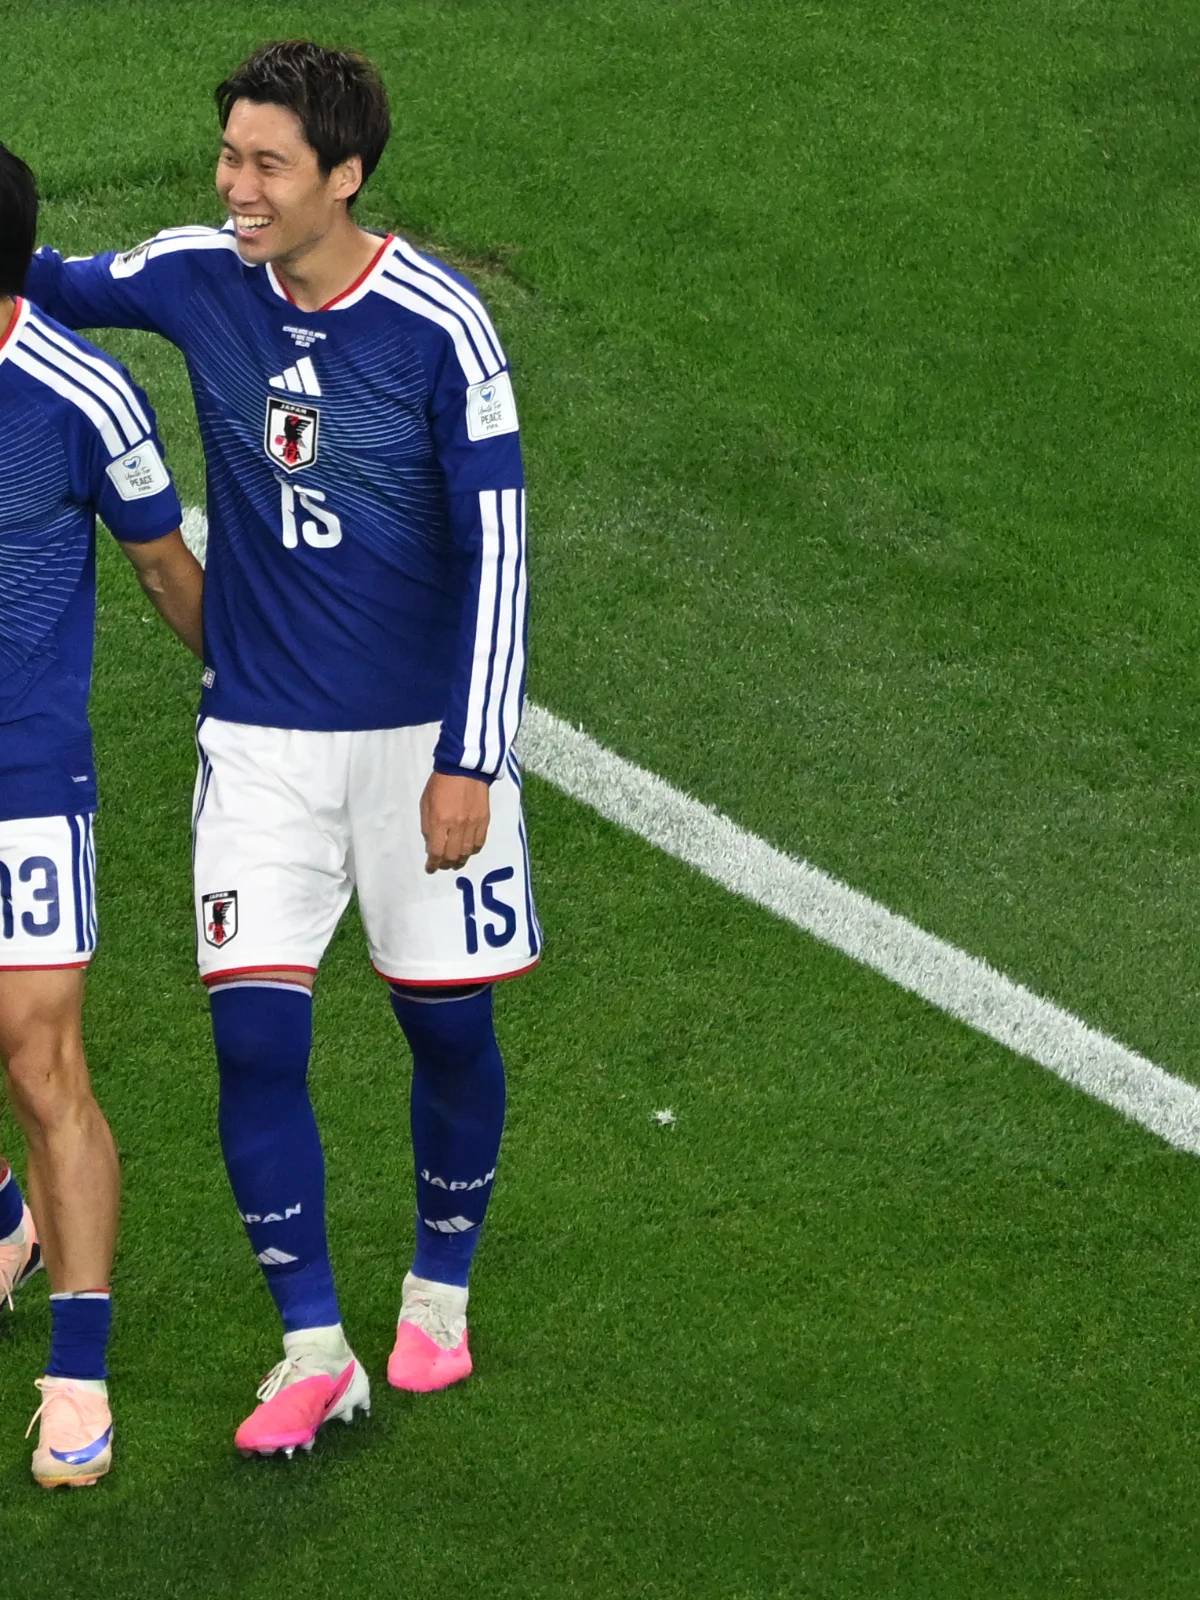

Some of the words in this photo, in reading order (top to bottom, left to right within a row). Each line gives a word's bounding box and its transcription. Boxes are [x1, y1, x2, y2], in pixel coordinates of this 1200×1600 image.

[280, 403, 307, 415] JAPAN
[481, 411, 504, 425] PEACE
[130, 474, 154, 488] PEACE
[273, 472, 343, 549] 15
[456, 866, 517, 955] 15
[420, 1167, 496, 1191] JAPAN
